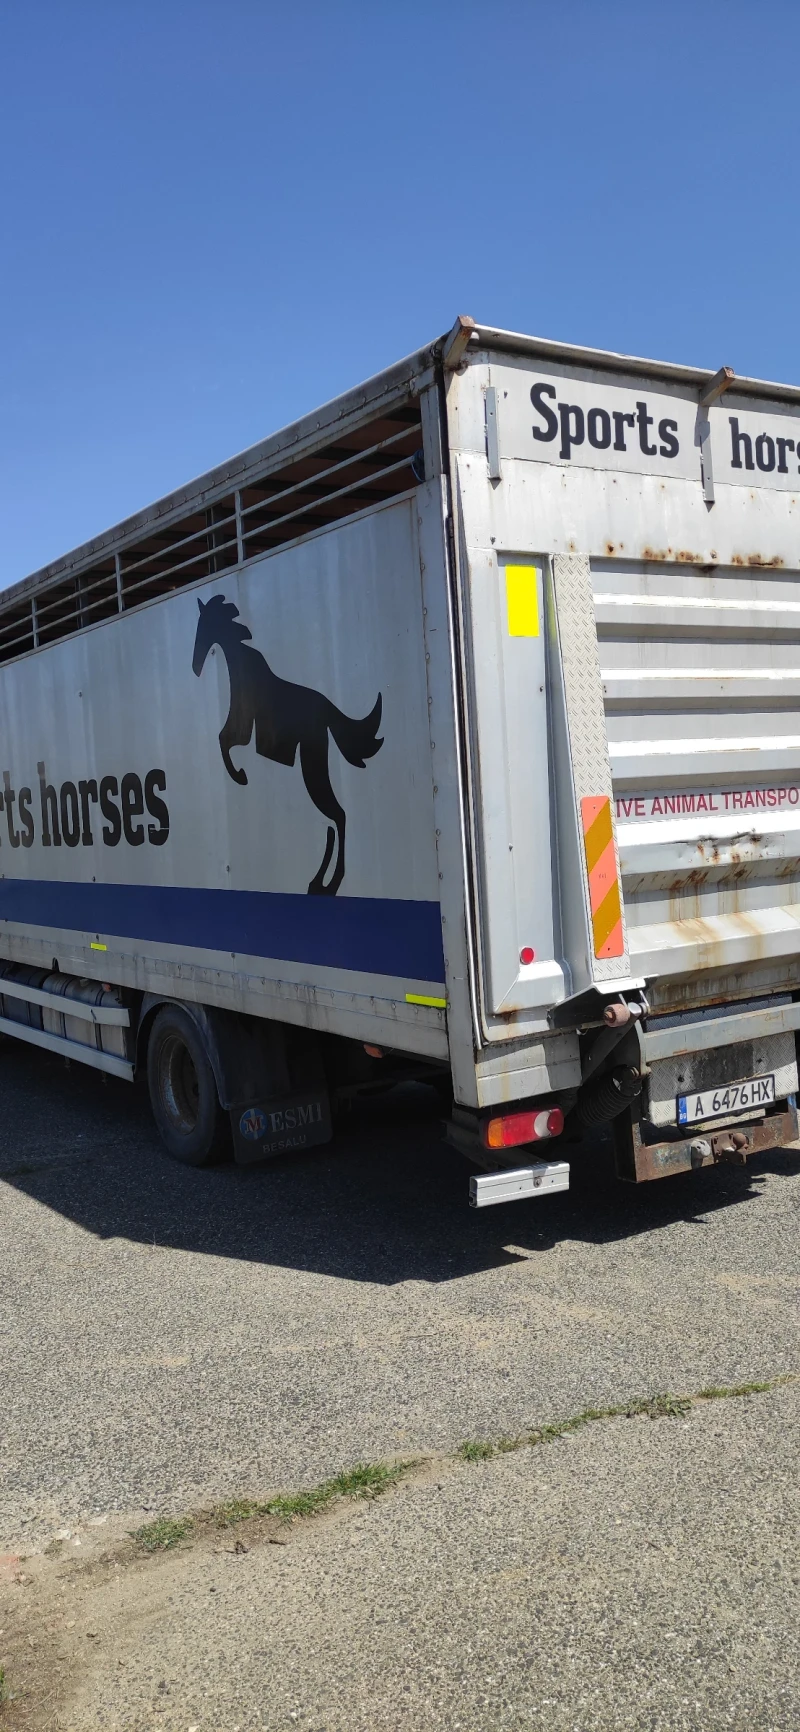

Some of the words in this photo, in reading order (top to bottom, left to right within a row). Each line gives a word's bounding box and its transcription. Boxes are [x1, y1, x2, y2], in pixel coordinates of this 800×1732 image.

[530, 382, 679, 460] Sports
[728, 416, 800, 475] hor
[0, 770, 34, 848] ts
[37, 761, 170, 848] horses
[615, 797, 646, 818] IVE
[650, 792, 719, 816] ANIMAL
[721, 786, 800, 811] TRANSPO
[695, 1095, 704, 1117] A
[712, 1085, 749, 1112] 6476
[751, 1079, 771, 1103] HX
[262, 1134, 307, 1154] BESALU
